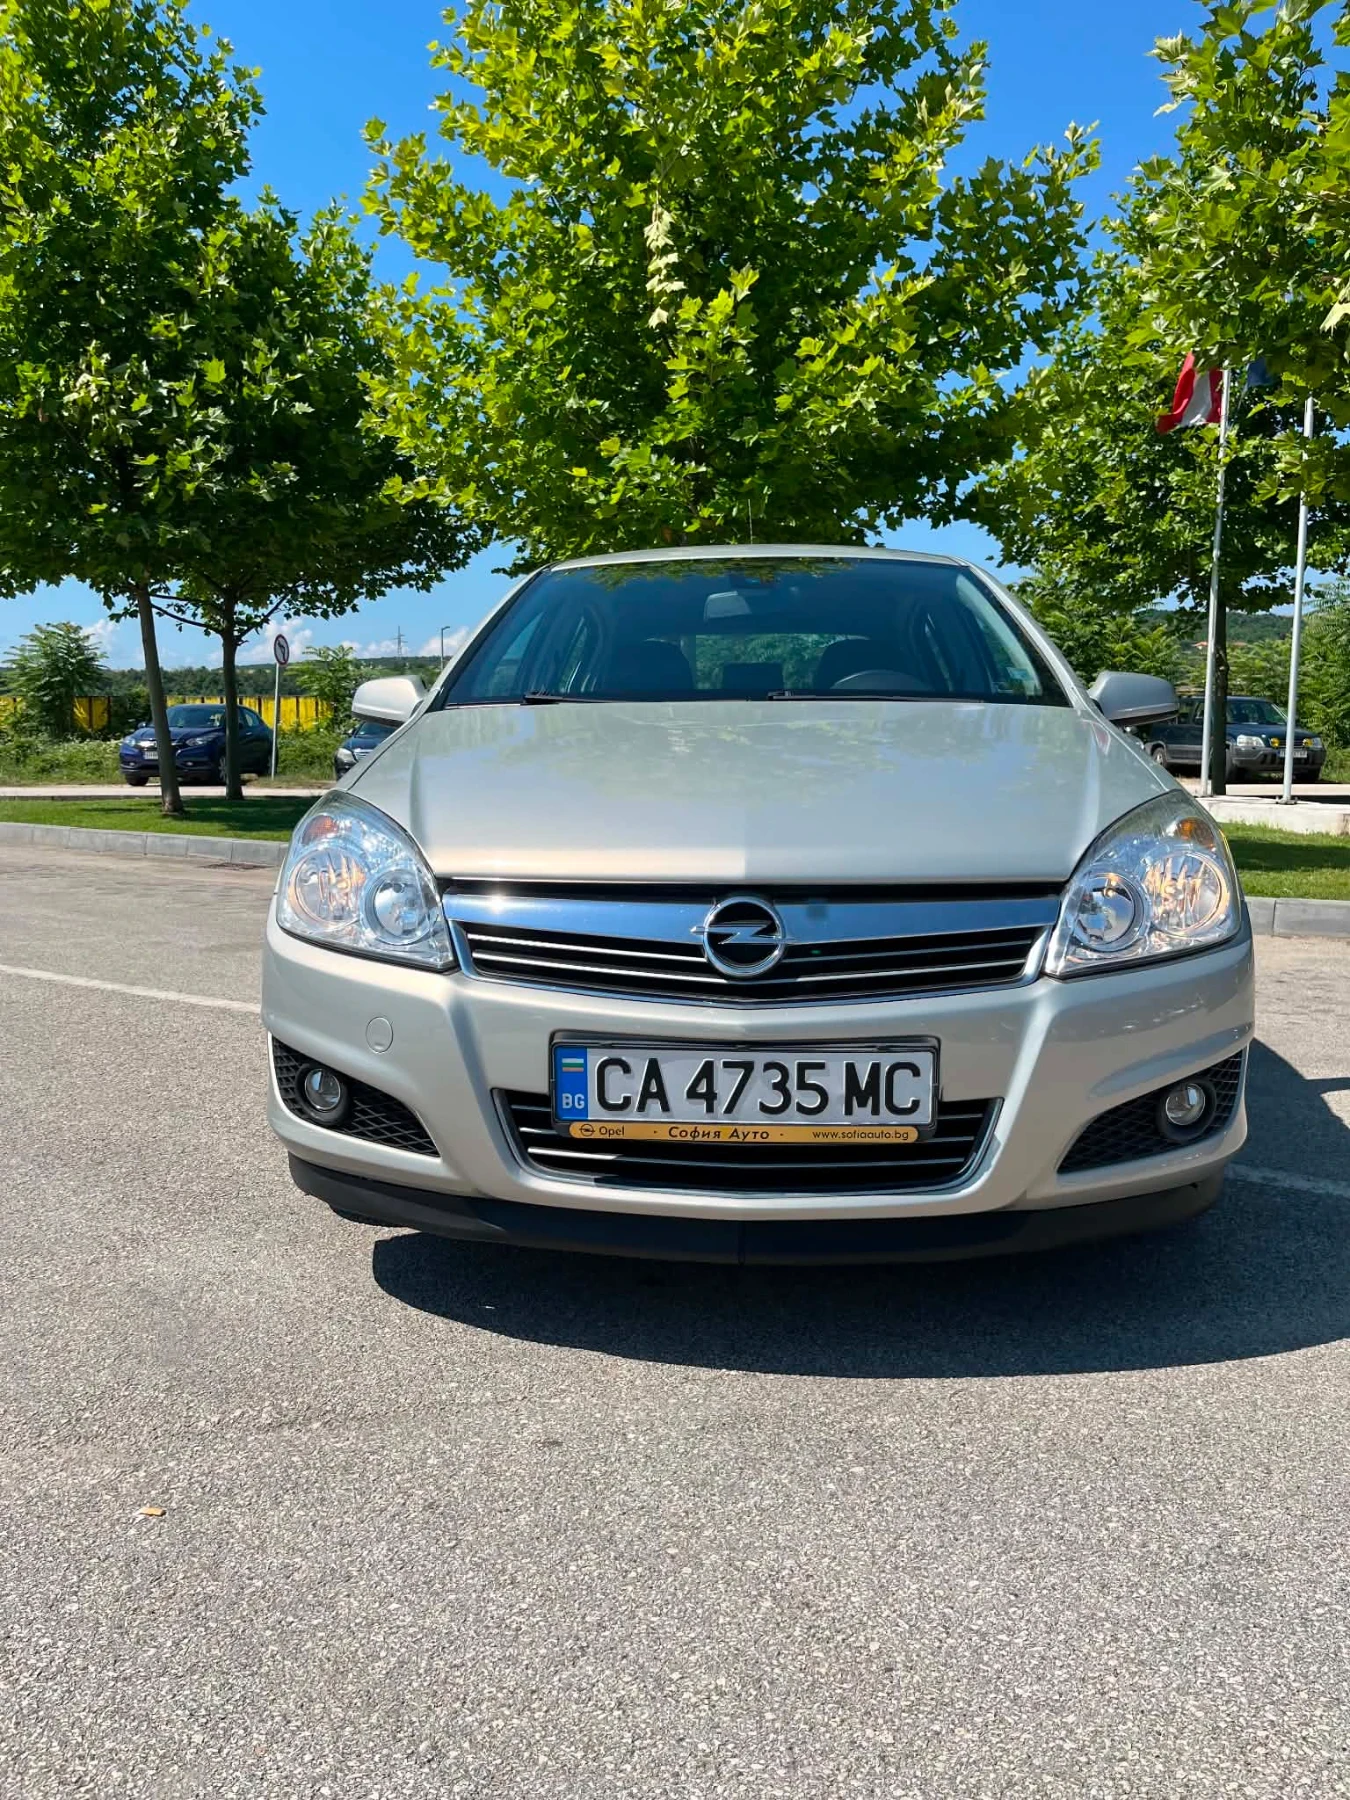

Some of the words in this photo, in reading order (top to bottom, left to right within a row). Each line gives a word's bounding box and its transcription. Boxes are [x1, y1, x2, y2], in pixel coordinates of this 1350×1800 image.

[595, 1057, 670, 1113] CA
[685, 1059, 829, 1116] 4735
[843, 1061, 921, 1116] MC
[561, 1093, 585, 1109] BG
[598, 1125, 625, 1138] Opel
[668, 1126, 721, 1140] София
[728, 1127, 770, 1141] Ауто
[812, 1129, 909, 1141] www.sofiaauto.bg
